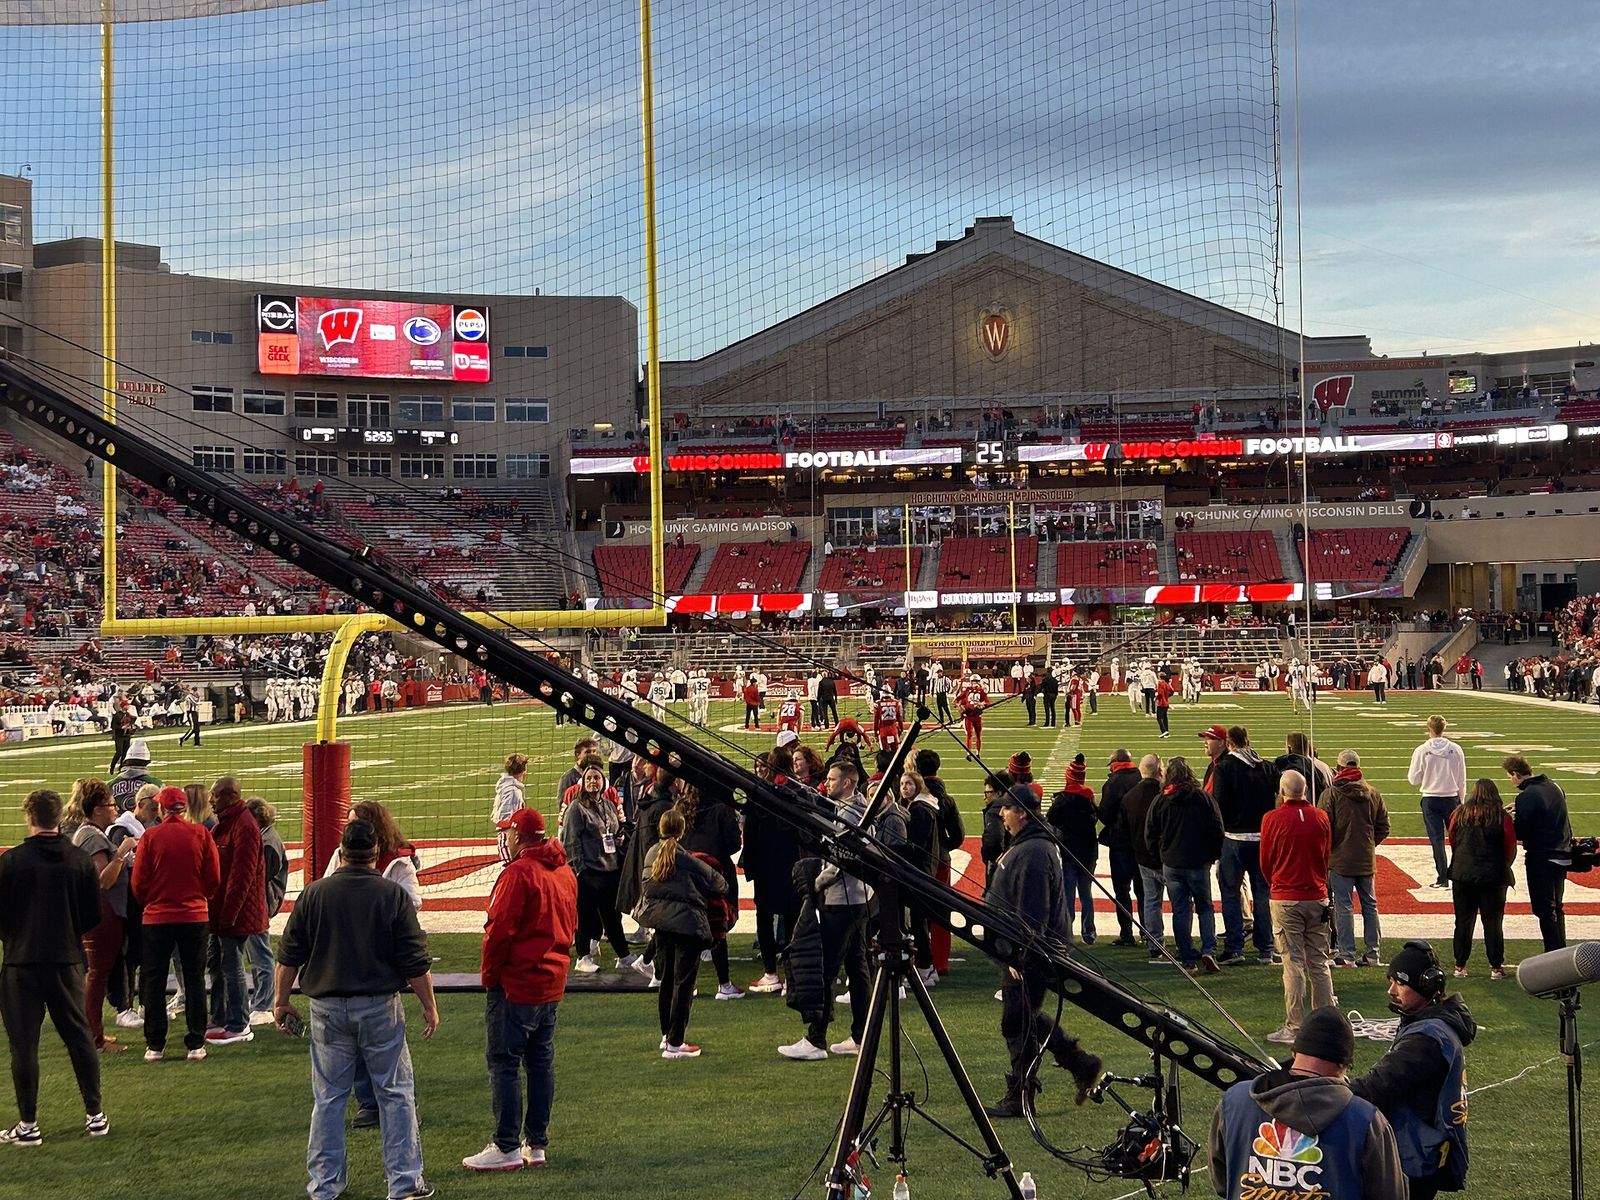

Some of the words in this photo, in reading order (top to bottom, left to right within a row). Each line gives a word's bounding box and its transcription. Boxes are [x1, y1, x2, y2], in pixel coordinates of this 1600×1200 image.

[985, 321, 1006, 350] W
[268, 345, 289, 353] SEAT
[267, 353, 290, 362] GEEK
[1371, 386, 1428, 399] summit
[978, 443, 1003, 463] 25
[1121, 439, 1243, 459] WISCONSIN
[1247, 436, 1360, 455] FOOTBALL
[669, 453, 782, 471] WISCONSIN
[786, 450, 892, 468] FOOTBALL
[959, 491, 993, 502] GAMING
[996, 490, 1047, 501] CHAMPIONS
[1051, 490, 1074, 500] CLUB
[1243, 508, 1293, 519] GAMING
[1296, 507, 1365, 518] WISCONSIN
[1368, 505, 1405, 517] DELLS
[692, 522, 738, 533] GAMING
[696, 681, 707, 691] 35
[112, 779, 146, 797] IRIS
[1248, 1155, 1324, 1191] NBC
